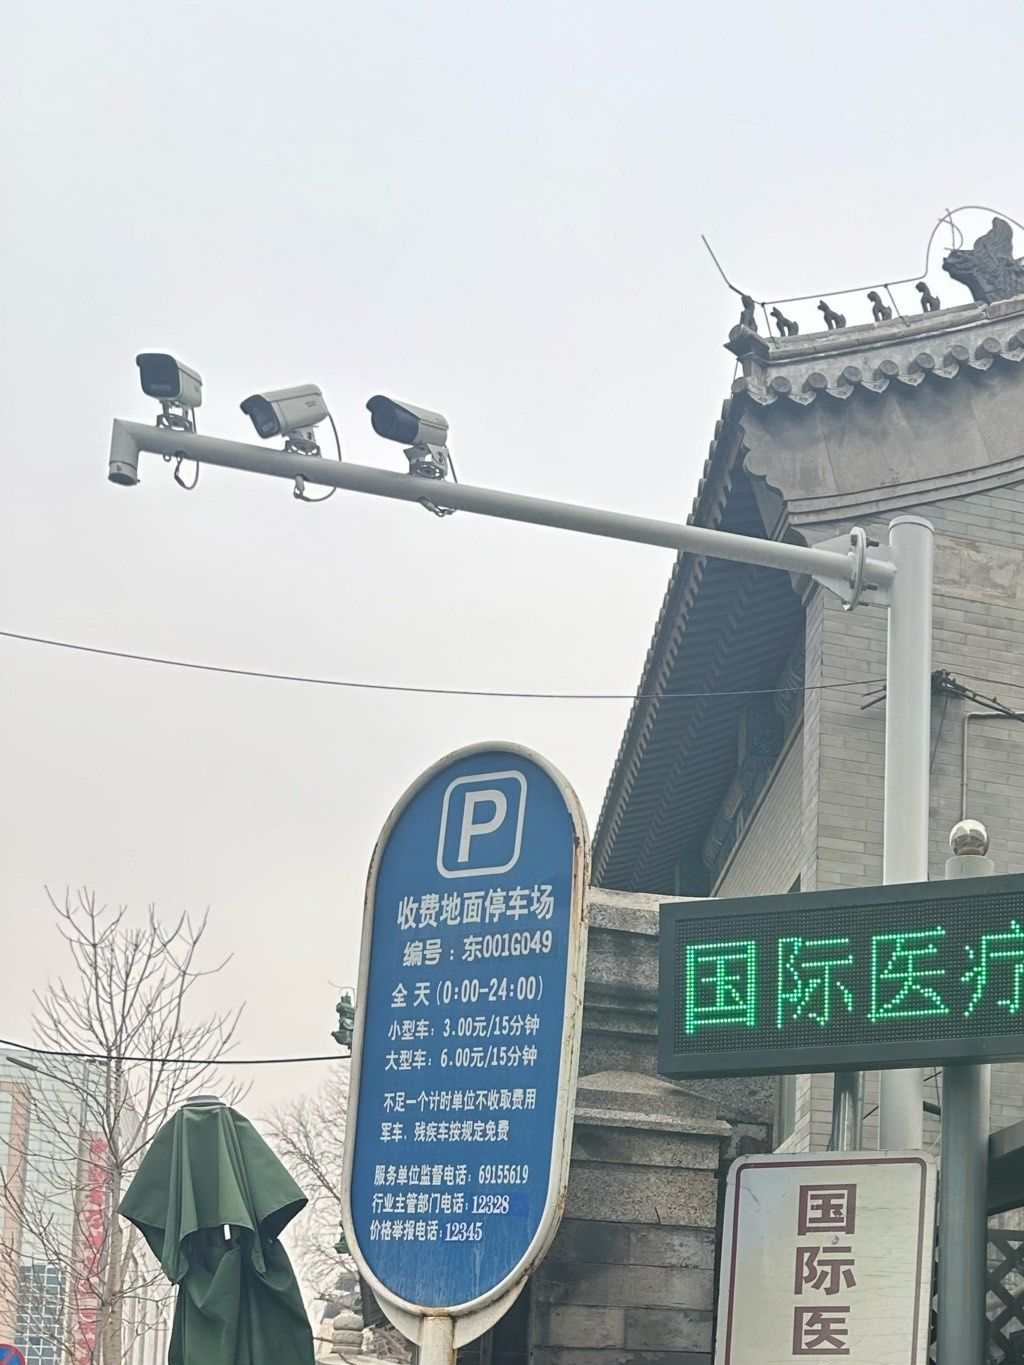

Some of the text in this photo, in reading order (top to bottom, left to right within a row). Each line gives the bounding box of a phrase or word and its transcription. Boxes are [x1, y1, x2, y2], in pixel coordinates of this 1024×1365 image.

[456, 788, 508, 863] P
[397, 884, 554, 930] 收费地面停车场
[383, 1088, 537, 1113] 不足一个计时单位不收取费用
